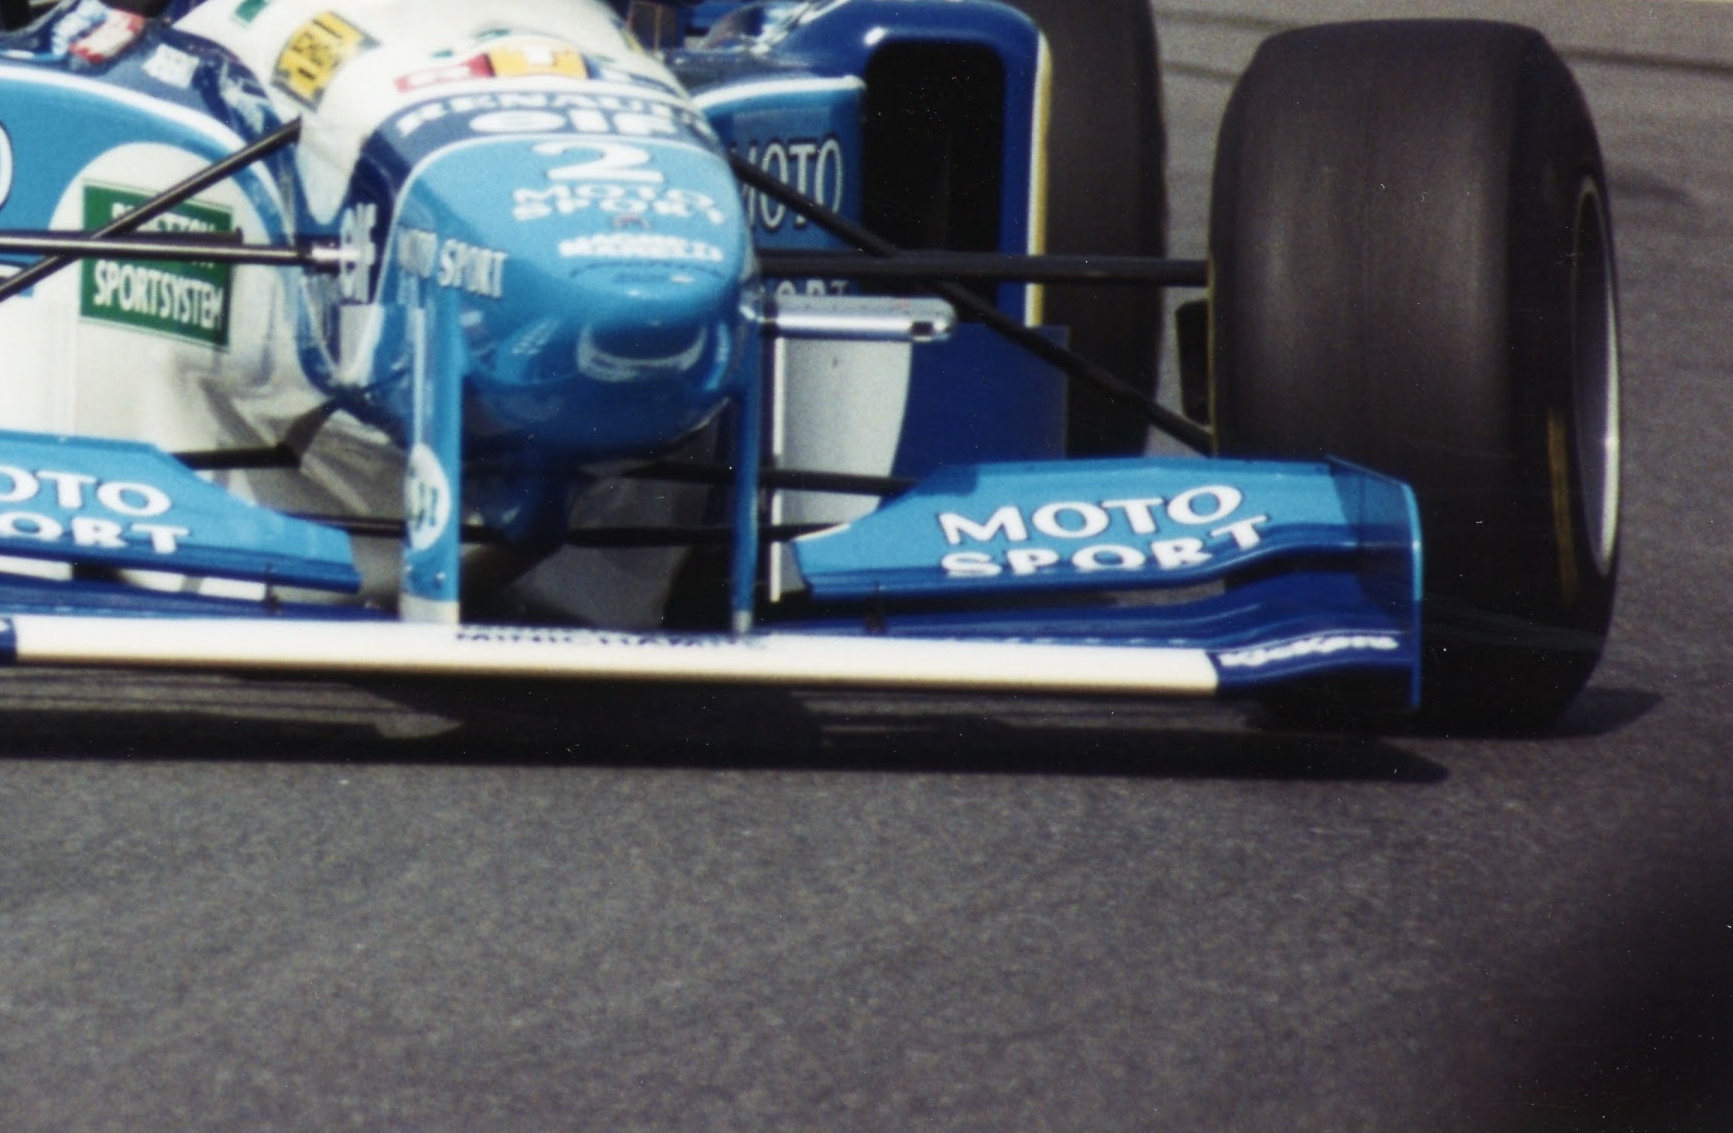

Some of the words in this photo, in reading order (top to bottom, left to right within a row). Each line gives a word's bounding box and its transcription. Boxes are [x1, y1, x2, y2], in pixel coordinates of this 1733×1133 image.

[532, 139, 663, 184] 2
[93, 259, 224, 330] SPORTSYSTEM
[938, 484, 1243, 545] MOTO
[940, 514, 1269, 577] SPORT
